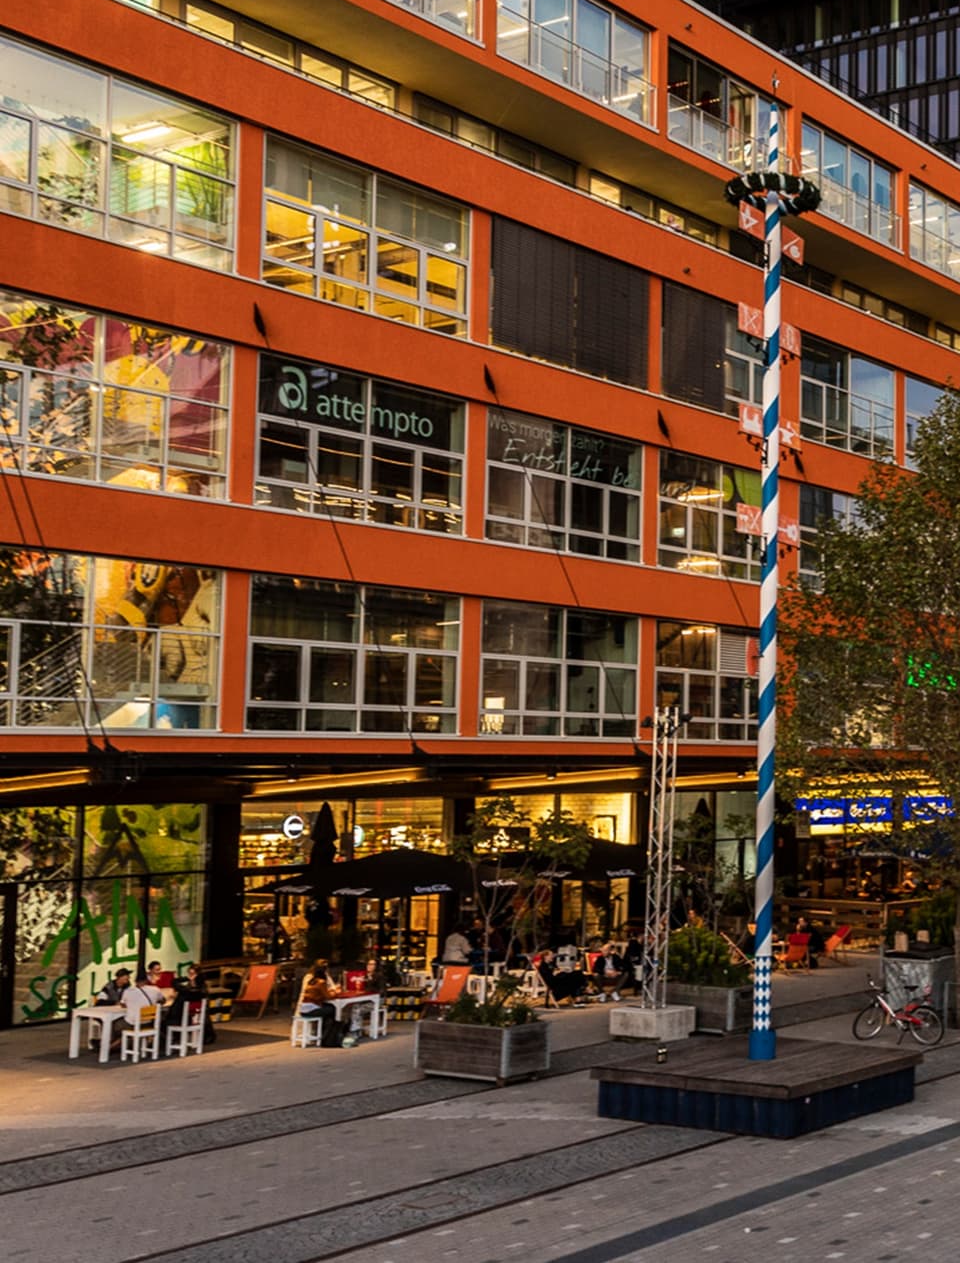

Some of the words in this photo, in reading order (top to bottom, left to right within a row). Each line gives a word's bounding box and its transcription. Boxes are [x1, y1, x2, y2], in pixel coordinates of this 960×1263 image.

[316, 394, 434, 438] attempto
[488, 414, 518, 434] Was
[502, 437, 604, 480] Entsteht
[40, 879, 189, 968] ALM
